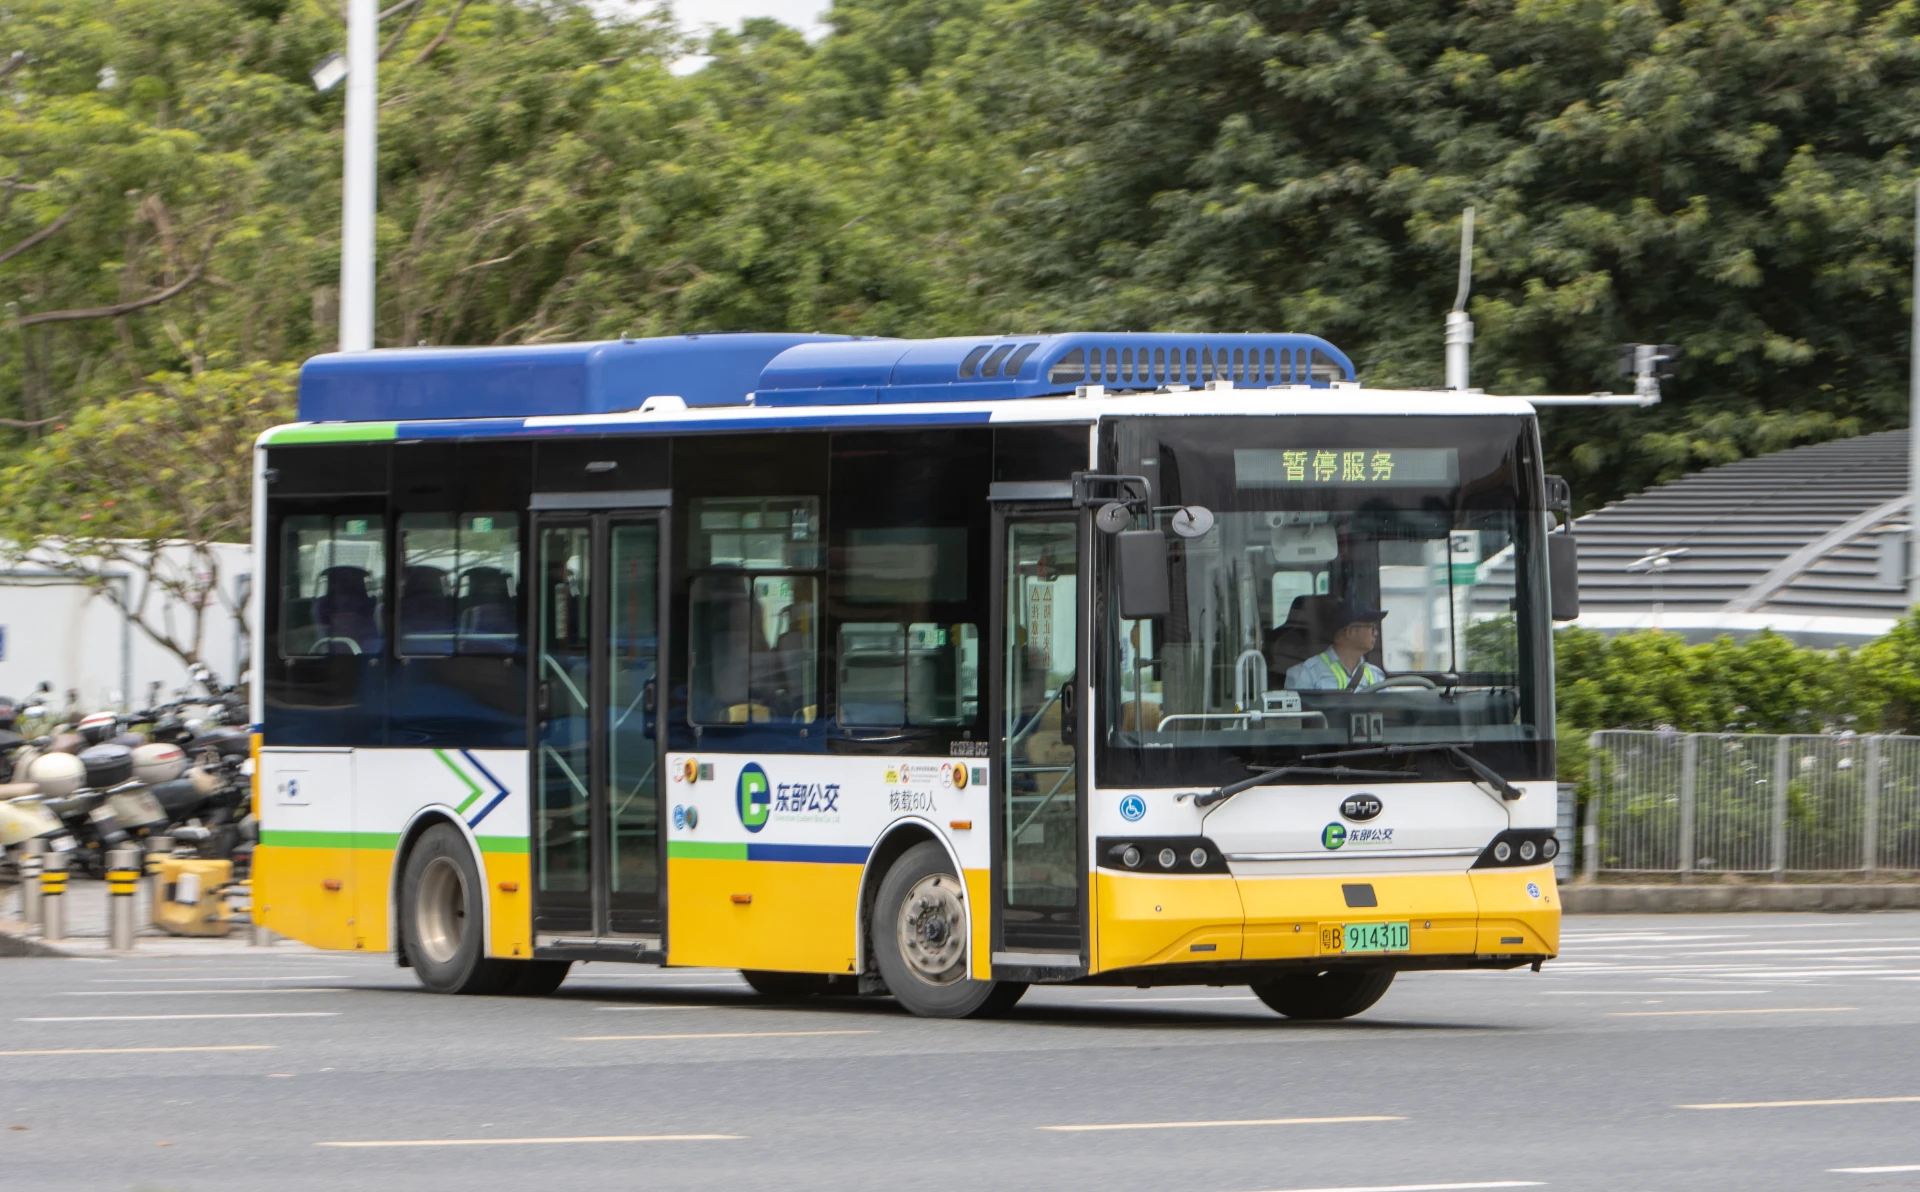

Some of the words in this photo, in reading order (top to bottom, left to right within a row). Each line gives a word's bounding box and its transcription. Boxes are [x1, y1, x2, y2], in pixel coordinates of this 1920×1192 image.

[1282, 450, 1395, 481] 暂停服务
[774, 782, 840, 812] 东部公交
[889, 789, 937, 812] 核载60人
[1345, 801, 1380, 814] BYD
[1348, 828, 1394, 841] 东部公交
